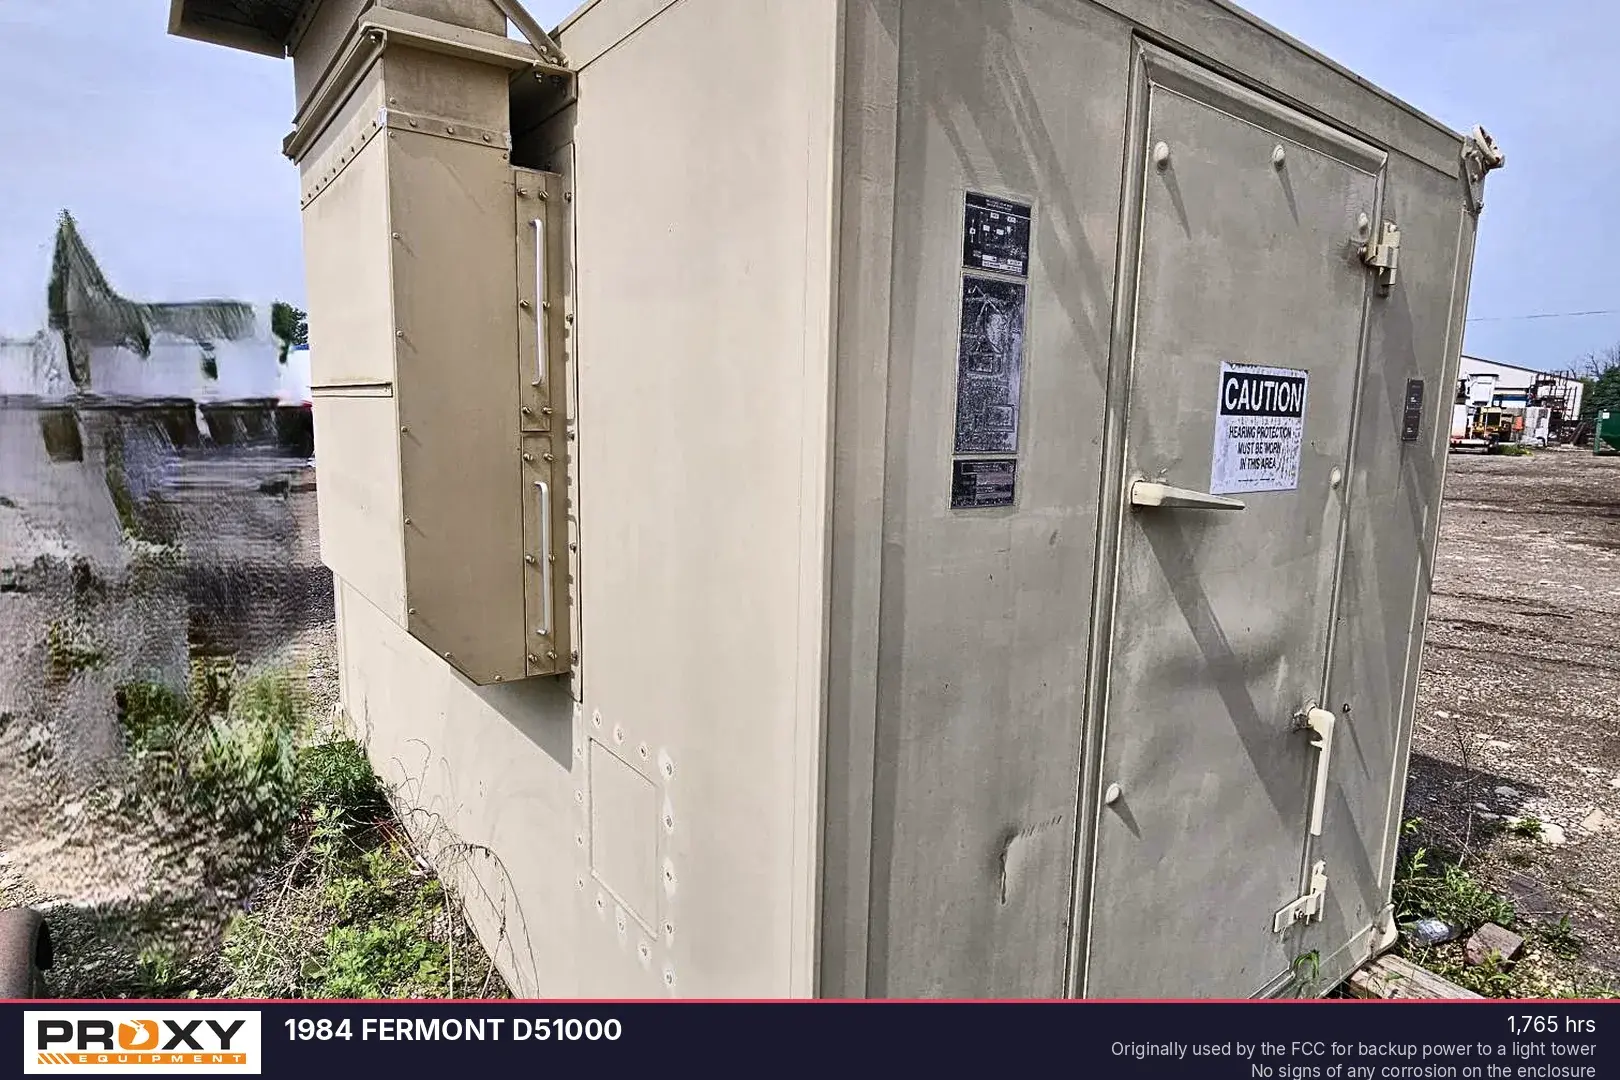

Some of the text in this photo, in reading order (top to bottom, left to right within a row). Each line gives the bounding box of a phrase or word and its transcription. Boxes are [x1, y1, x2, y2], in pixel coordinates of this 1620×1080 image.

[1225, 377, 1302, 412] CAUTION
[1229, 425, 1292, 439] HEARING PROTECTION
[1237, 441, 1281, 455] MUST BE WORN
[1239, 457, 1276, 470] IN THIS AREA
